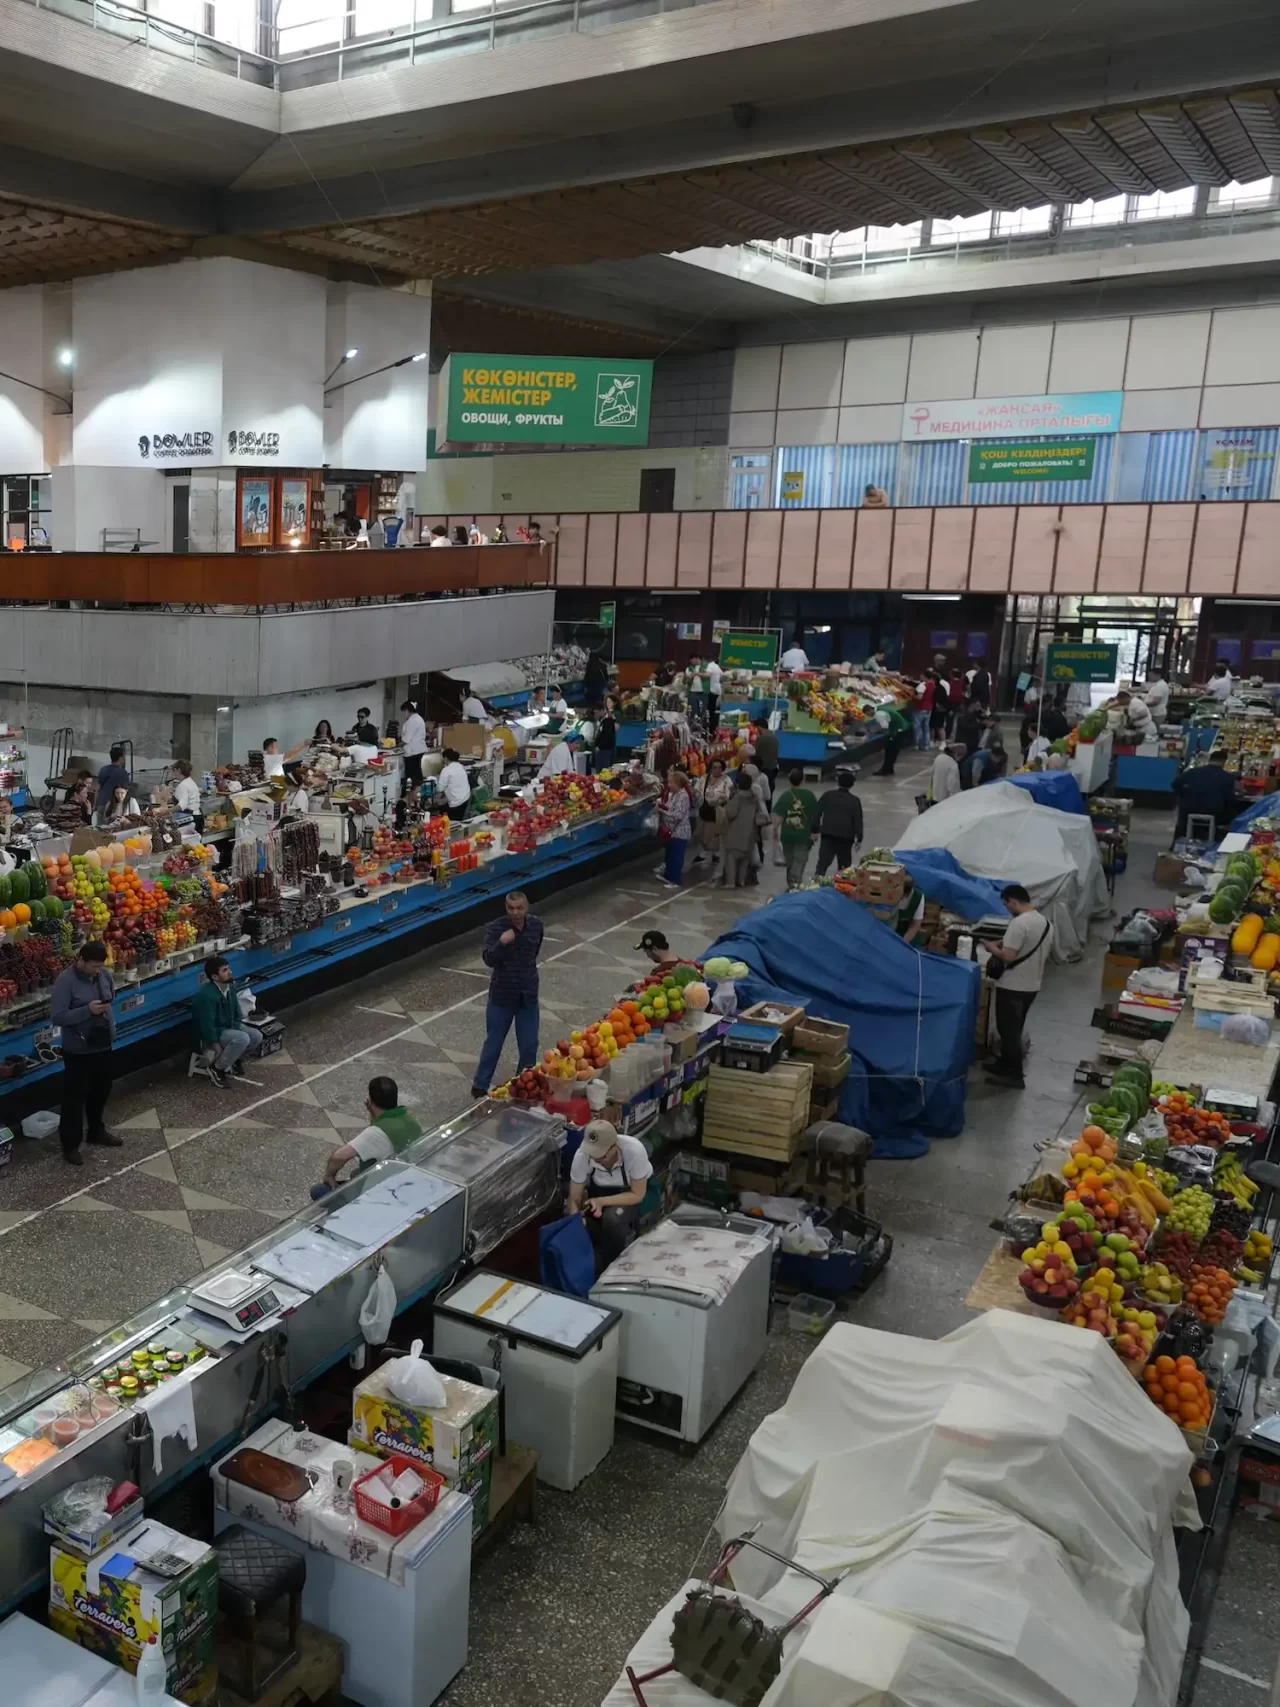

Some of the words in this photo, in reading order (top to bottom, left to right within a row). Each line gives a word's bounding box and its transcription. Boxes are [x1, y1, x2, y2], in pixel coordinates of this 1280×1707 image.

[462, 368, 578, 391] КӨКӨНІСТЕР,
[462, 388, 552, 406] ЖЕМІСТЕР
[977, 402, 1061, 415] «ЖАНСАЯ»
[461, 412, 511, 426] ОВОЩИ,
[515, 413, 564, 426] ФРУКТЫ
[929, 417, 1014, 434] МЕДИЦИНА
[153, 432, 214, 448] BOWLER
[238, 431, 280, 447] BOWLER
[981, 450, 1008, 460] ҚОШ
[992, 461, 1018, 469] ДОБРО
[1019, 459, 1073, 467] ПОЖАЛОВАТЬ!
[373, 1430, 435, 1464] Terravera
[74, 1596, 137, 1640] Terravera
